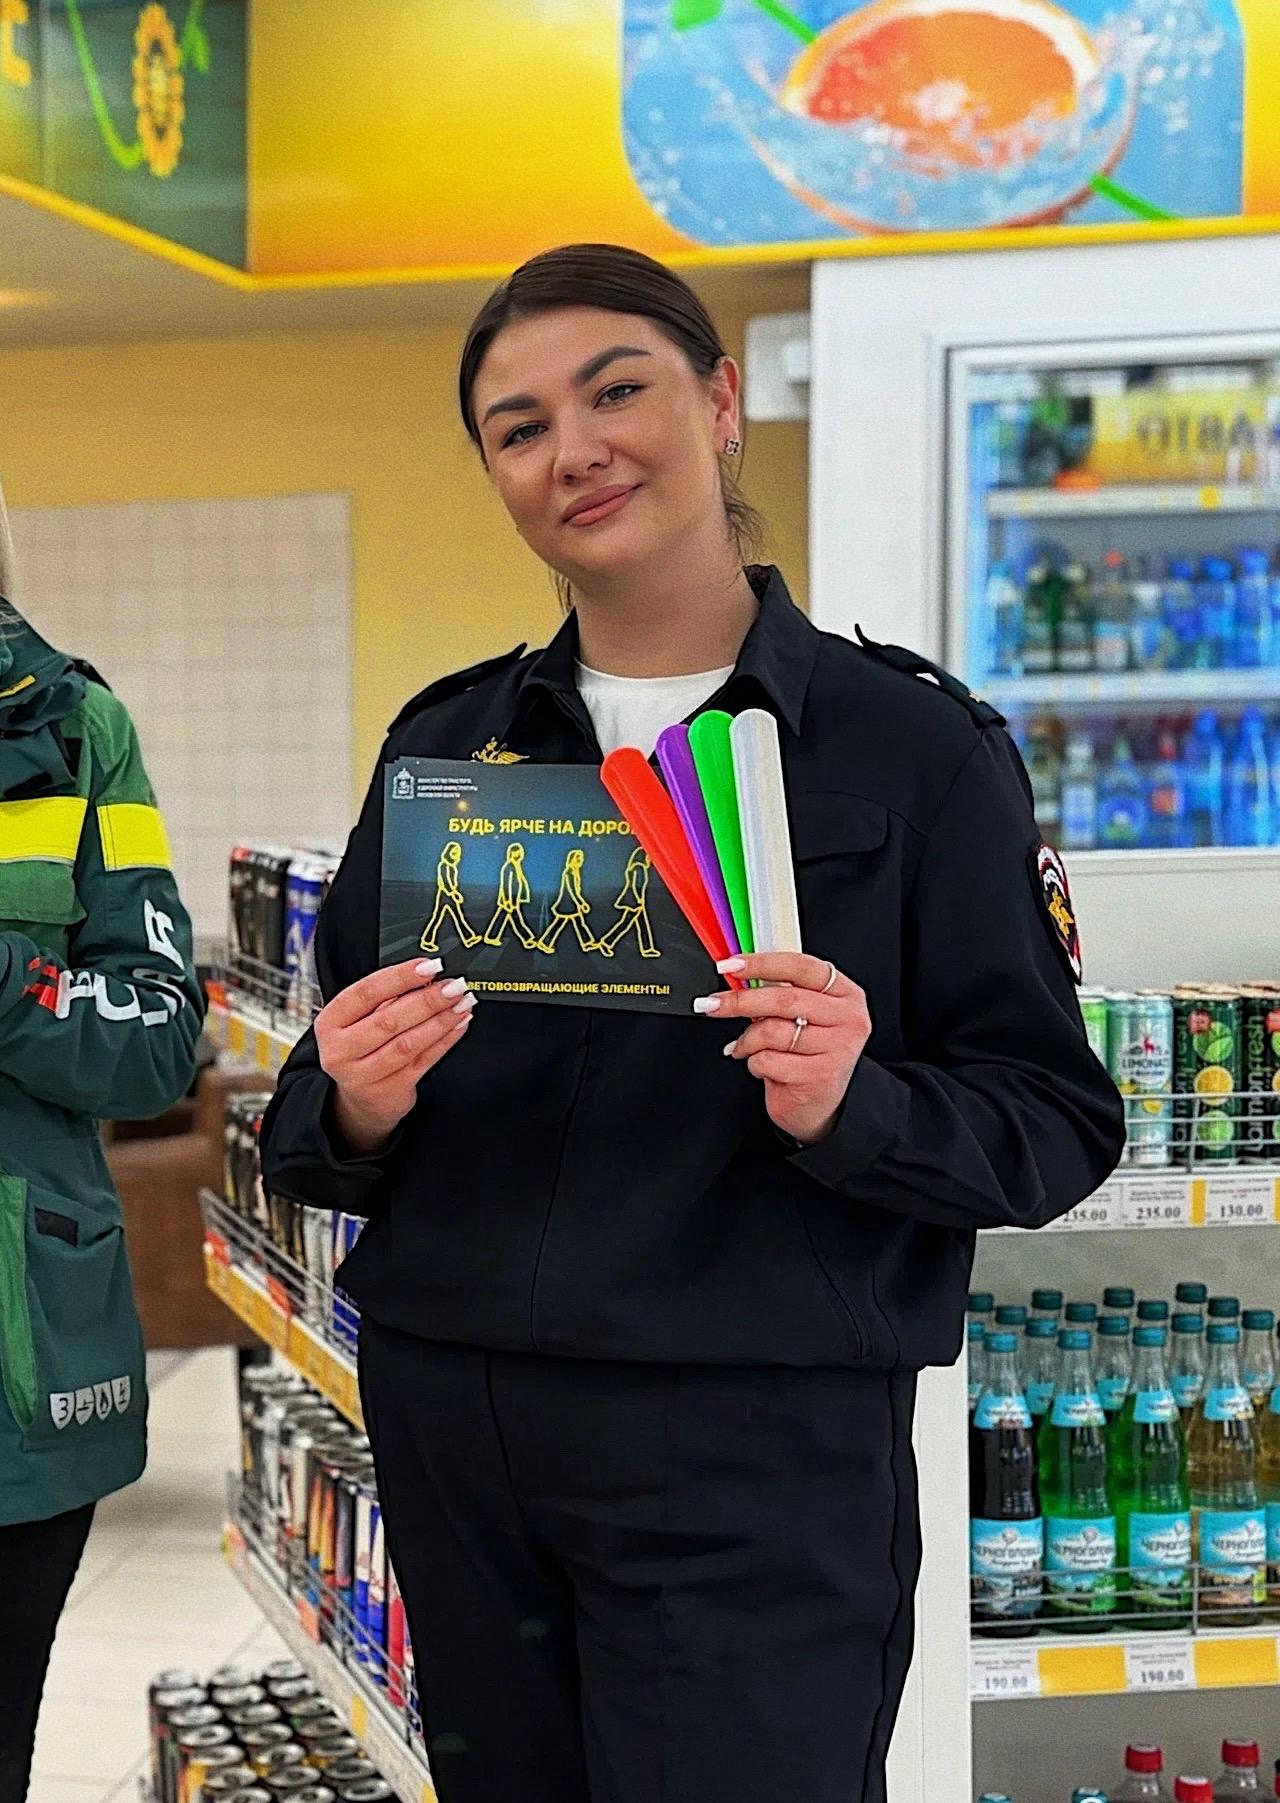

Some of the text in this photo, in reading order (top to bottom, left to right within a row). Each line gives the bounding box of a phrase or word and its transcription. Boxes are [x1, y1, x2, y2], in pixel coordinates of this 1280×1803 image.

[448, 817, 635, 837] БУДЬ ЯРЧЕ НА ДОРО
[465, 980, 670, 995] ВЕТОВОЗВРАЩАЮЩИЕ ЭЛЕМЕНТЫ!
[1135, 1205, 1182, 1220] 235.00
[1220, 1204, 1264, 1218] 130.00
[1140, 1669, 1185, 1683] 190.00
